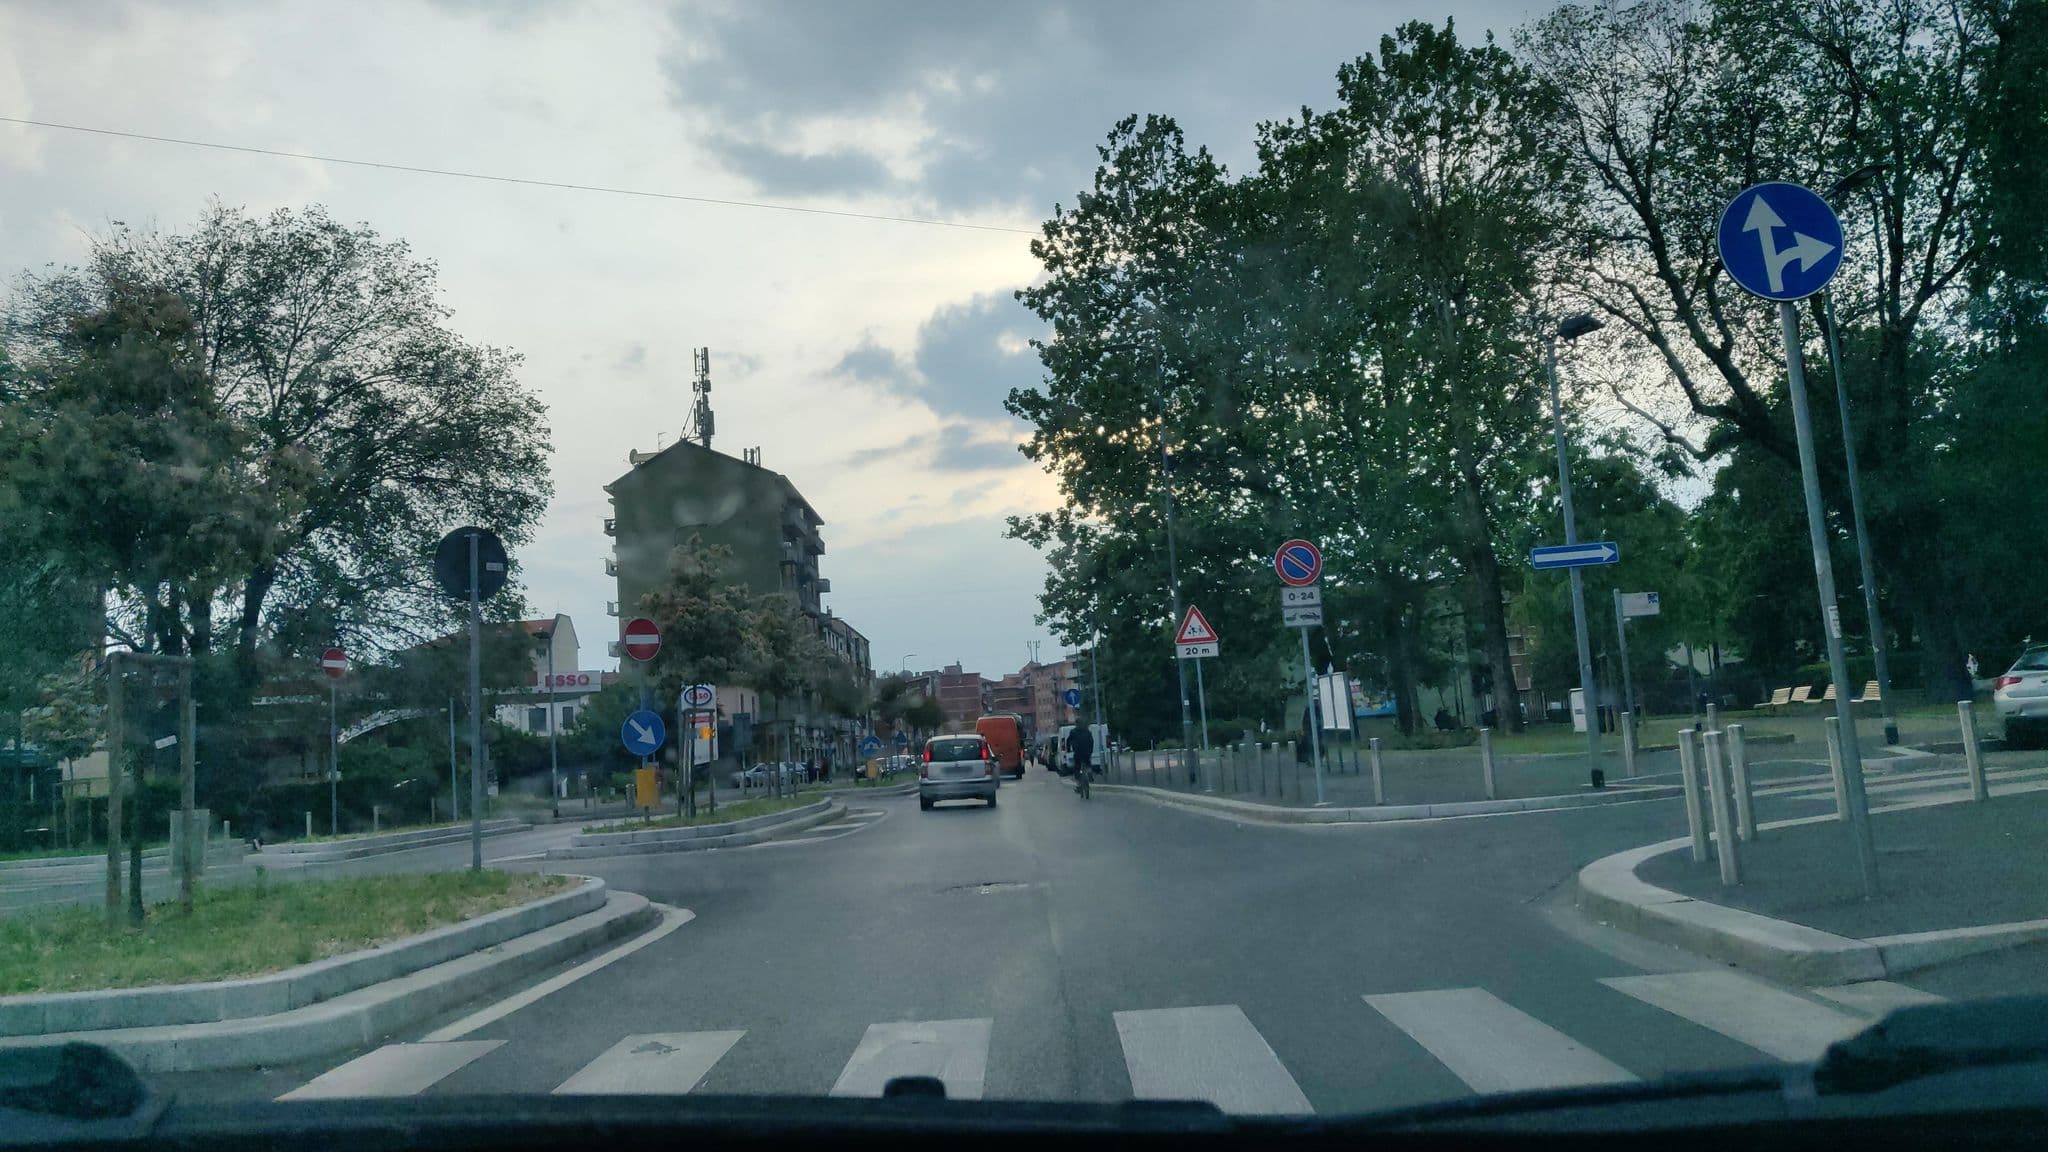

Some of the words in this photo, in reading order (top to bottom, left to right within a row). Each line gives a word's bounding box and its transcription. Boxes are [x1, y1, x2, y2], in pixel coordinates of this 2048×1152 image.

[1288, 592, 1314, 601] 0-24
[1185, 647, 1198, 655] 20
[545, 674, 590, 687] ESSO
